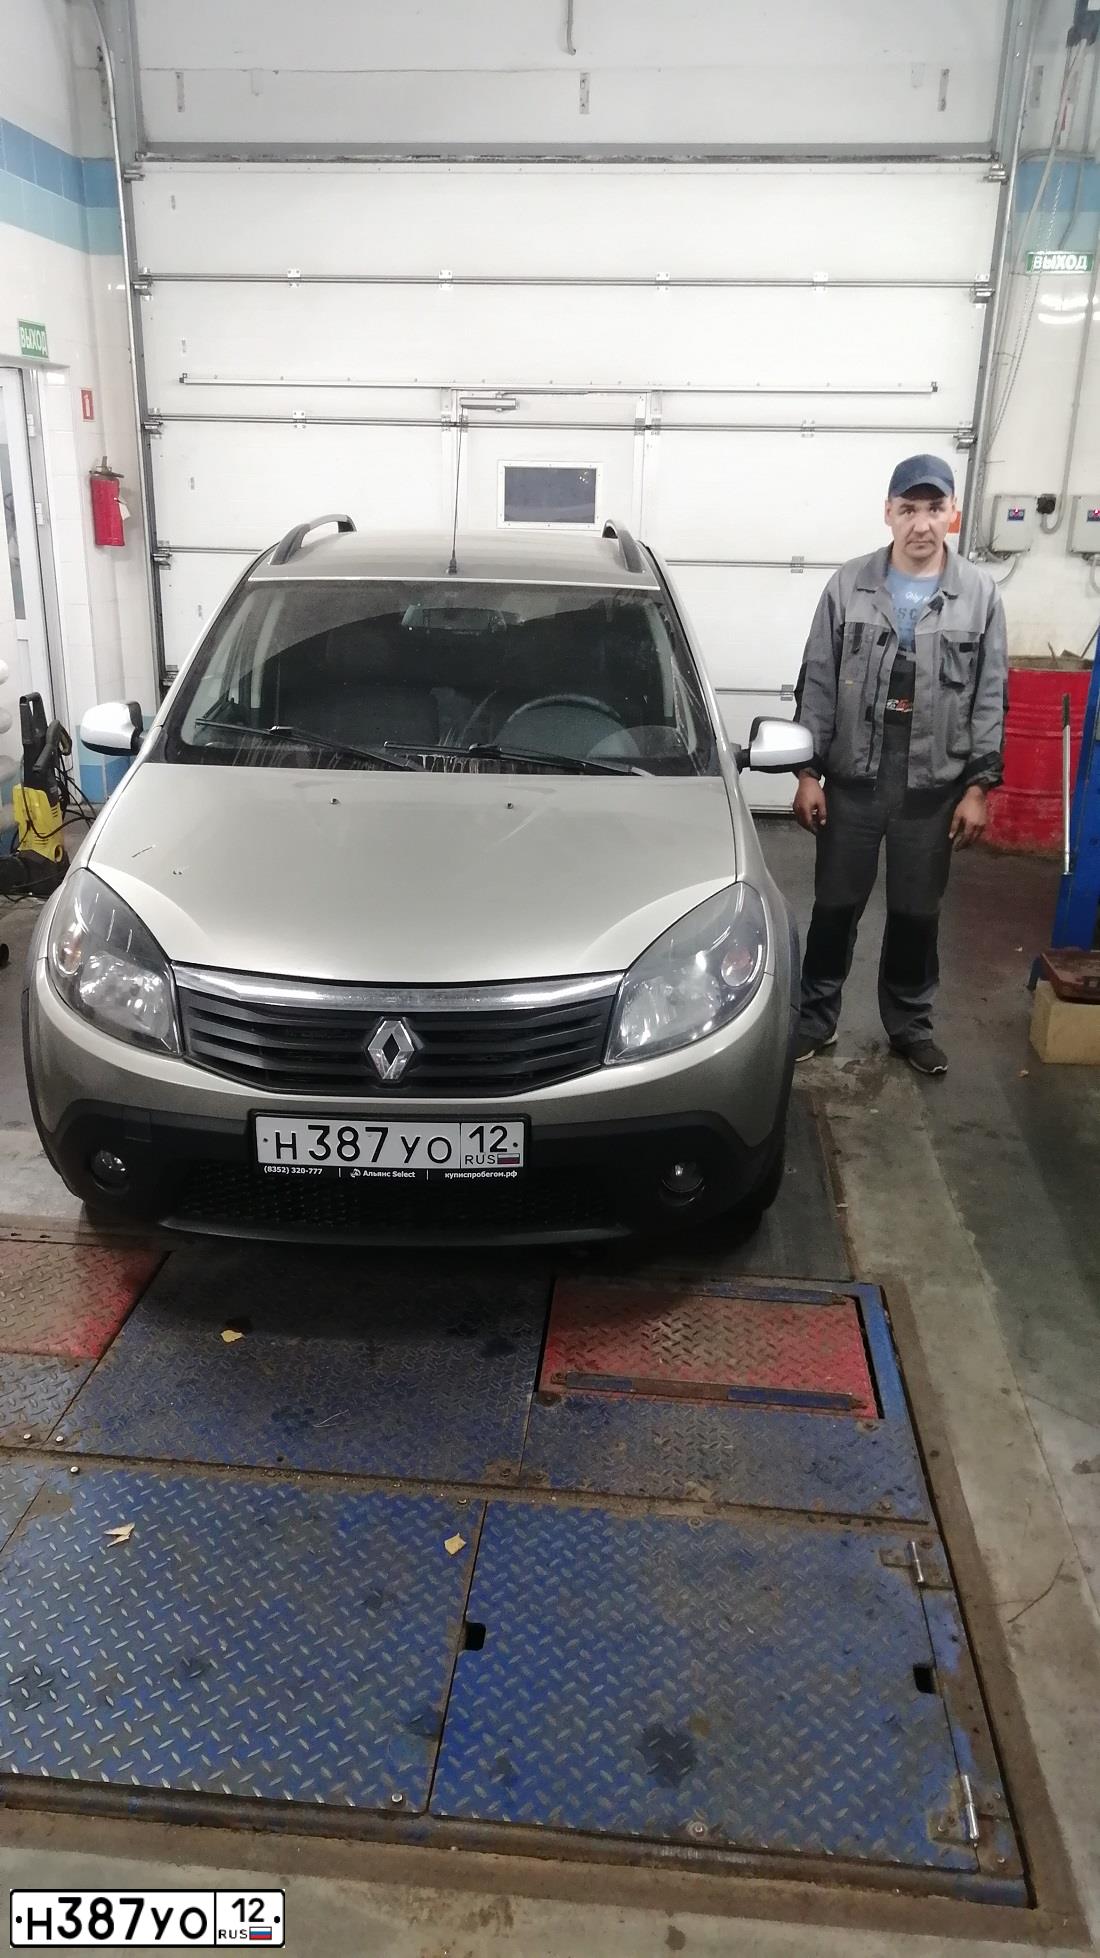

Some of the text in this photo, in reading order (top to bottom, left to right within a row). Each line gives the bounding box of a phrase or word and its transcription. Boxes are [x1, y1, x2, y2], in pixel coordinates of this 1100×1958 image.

[1033, 254, 1088, 271] ВЫХОД
[19, 326, 48, 356] ВЫХОД
[468, 1125, 508, 1153] 12
[464, 1154, 496, 1165] RUS
[263, 1165, 323, 1175] (8352) 320-777
[362, 1169, 416, 1178] Альянс Select
[444, 1170, 518, 1180] куписпробегом.рф
